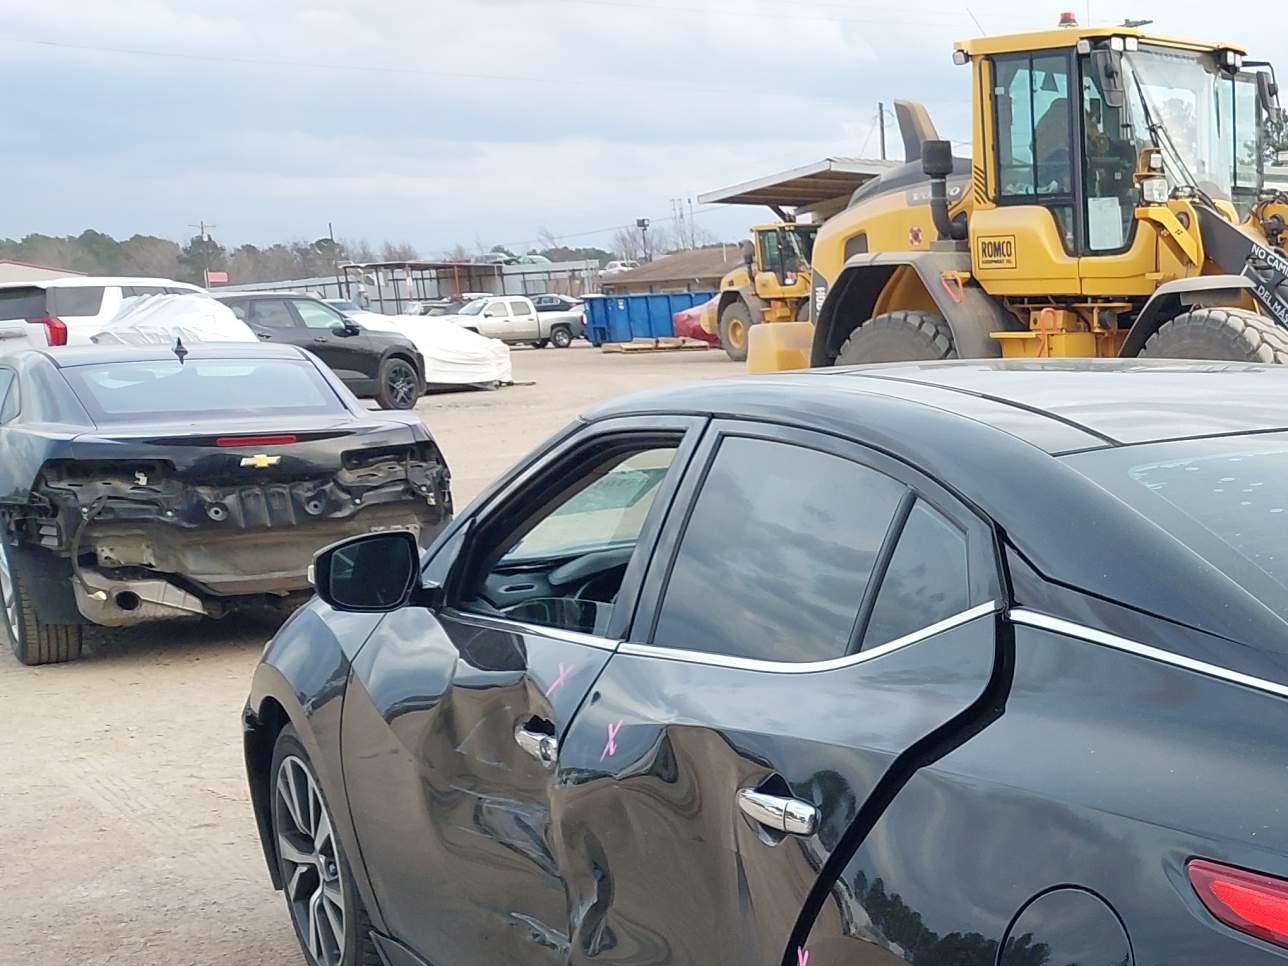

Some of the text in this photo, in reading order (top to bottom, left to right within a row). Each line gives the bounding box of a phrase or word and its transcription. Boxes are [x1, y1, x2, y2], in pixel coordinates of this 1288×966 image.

[981, 240, 1012, 258] ROMCO
[1251, 244, 1266, 259] NO
[1257, 285, 1273, 306] DEL
